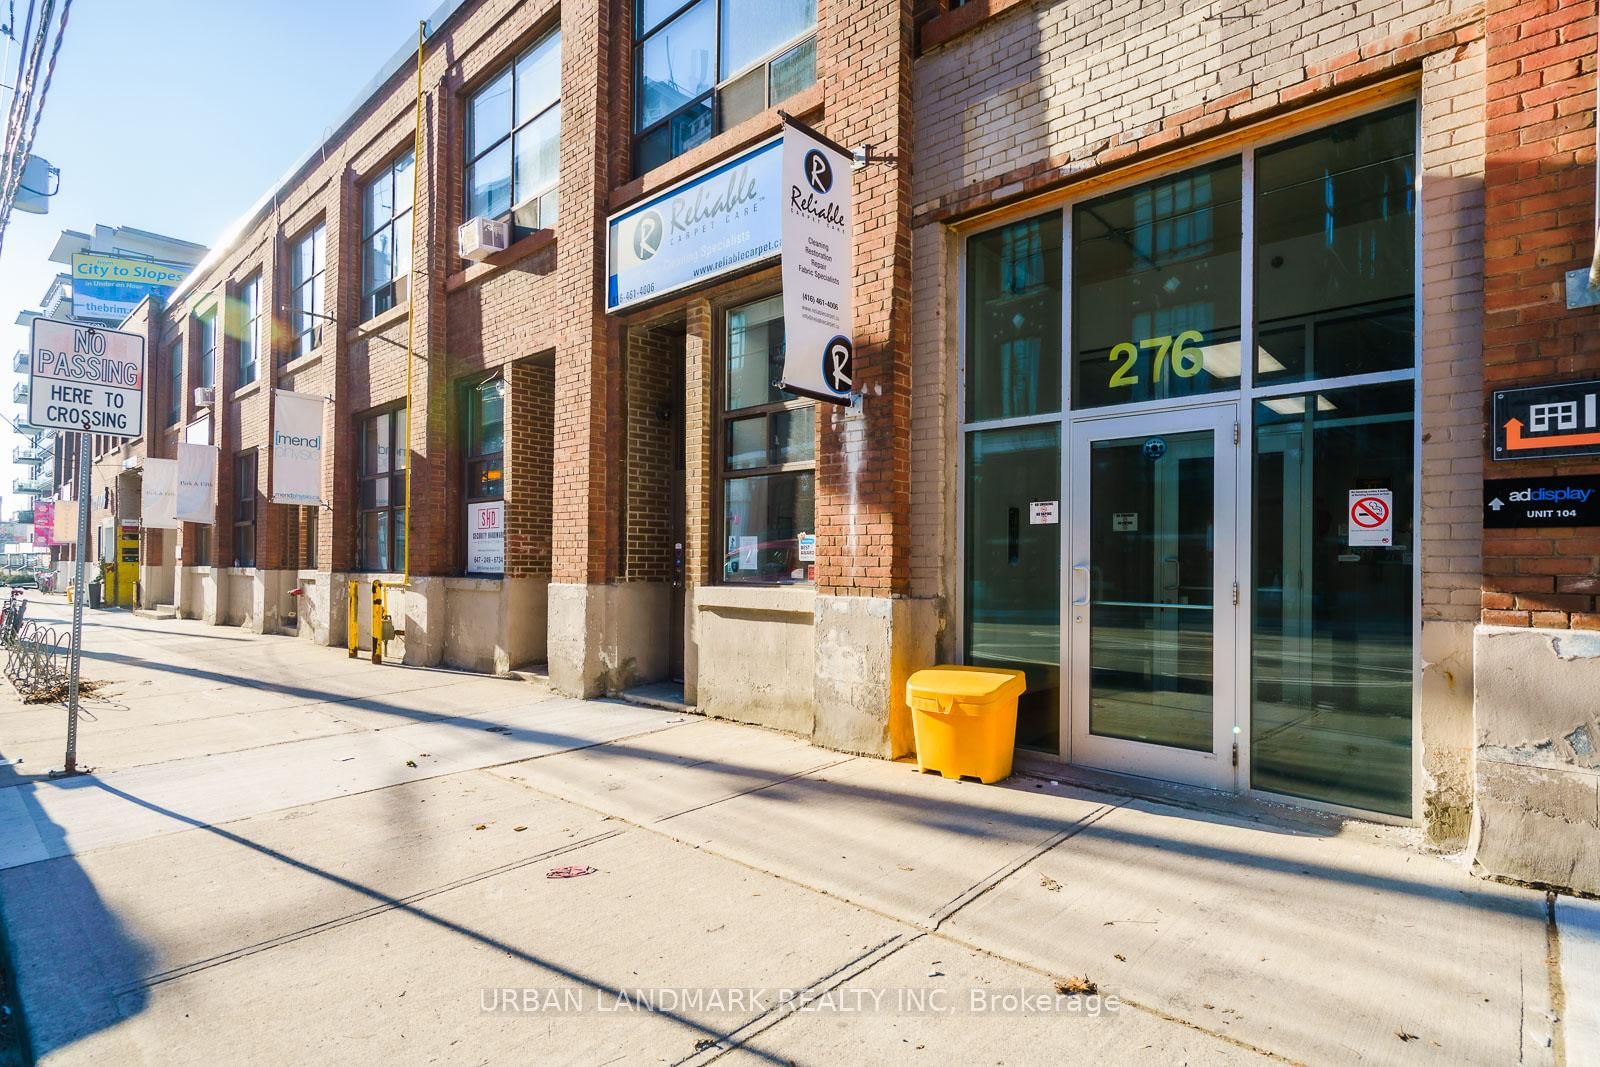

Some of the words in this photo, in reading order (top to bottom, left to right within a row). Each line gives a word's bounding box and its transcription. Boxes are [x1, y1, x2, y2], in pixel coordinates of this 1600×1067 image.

[670, 166, 757, 235] Reliable
[791, 185, 845, 226] Reliable
[670, 221, 716, 246] CARPET
[725, 205, 759, 224] CARE
[804, 246, 833, 263] Restoration
[807, 237, 830, 252] Cleaning
[77, 263, 109, 278] City
[113, 265, 129, 277] to
[133, 266, 183, 282] Slopes
[798, 265, 814, 277] Fabric
[814, 270, 840, 286] Specialists
[810, 259, 827, 271] Repair
[802, 292, 816, 305] (416)
[74, 328, 107, 356] NO
[38, 348, 138, 386] PASSING
[1108, 330, 1204, 389] 276
[51, 384, 93, 405] HERE
[105, 391, 124, 408] TO
[47, 405, 127, 429] CROSSING
[1508, 487, 1592, 503] addisplay
[481, 509, 496, 527] SHD
[1526, 510, 1554, 518] UNIT
[1556, 509, 1577, 518] 104
